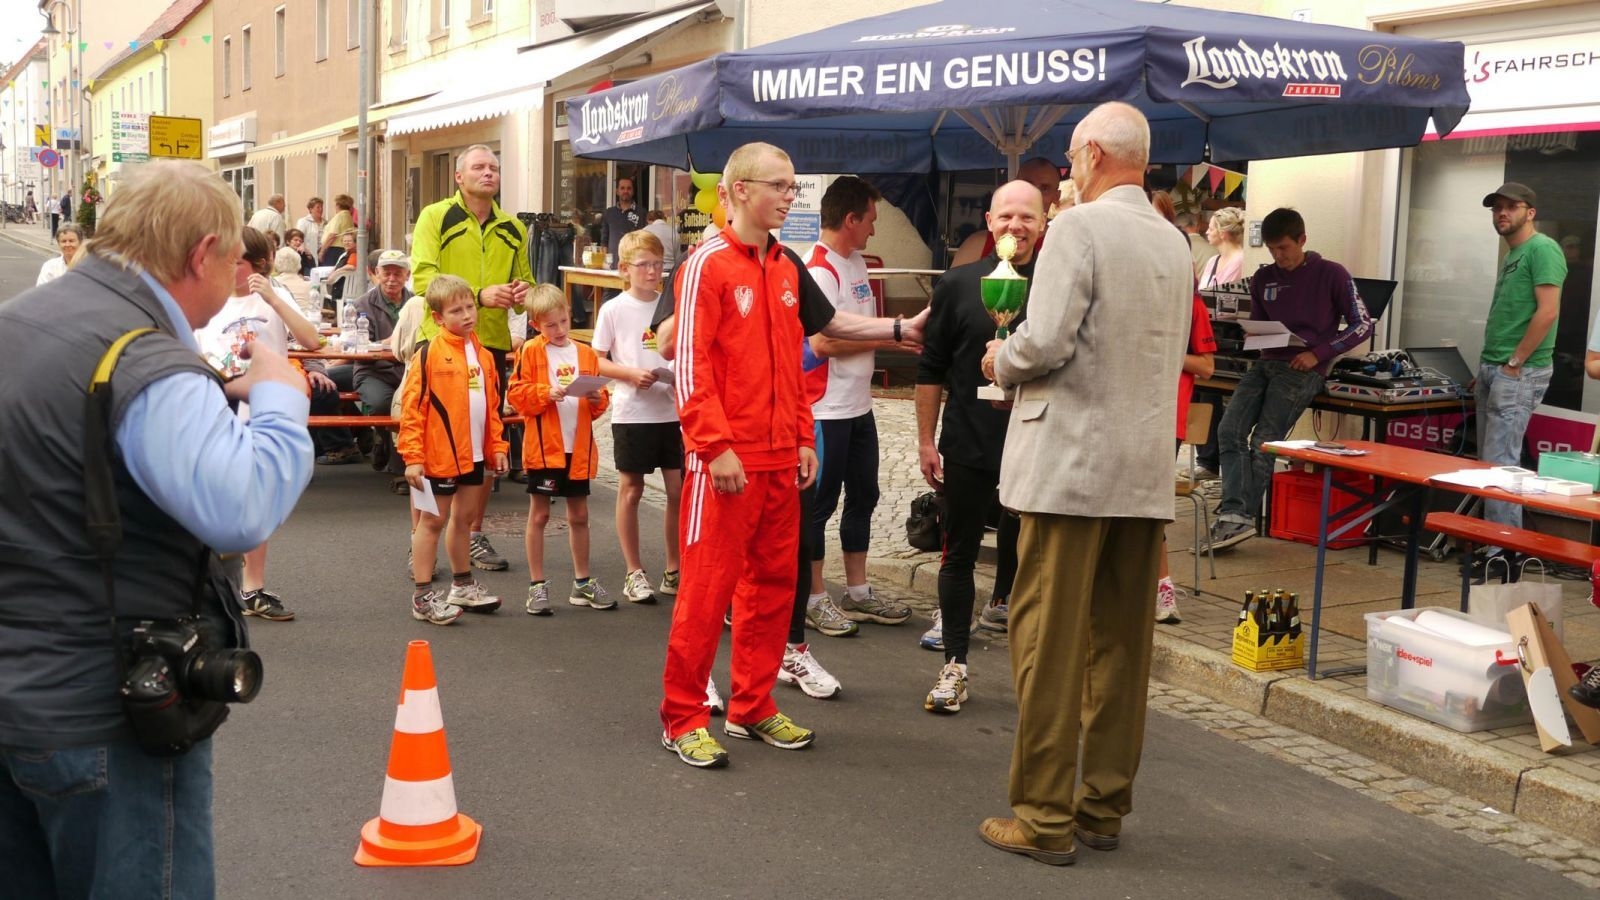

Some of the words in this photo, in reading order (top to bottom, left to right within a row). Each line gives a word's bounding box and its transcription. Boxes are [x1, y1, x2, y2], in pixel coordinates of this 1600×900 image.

[1181, 36, 1348, 89] Landskron
[1358, 44, 1442, 92] Pilsner
[1495, 51, 1600, 74] FAHRSCH
[752, 64, 864, 103] IMMER
[875, 61, 932, 95] EIN
[943, 48, 1107, 90] GENUSS!
[1288, 86, 1336, 95] PREMIUM
[575, 91, 650, 144] Landskron
[555, 366, 576, 379] ASV
[1396, 647, 1433, 668] idee+spiel
